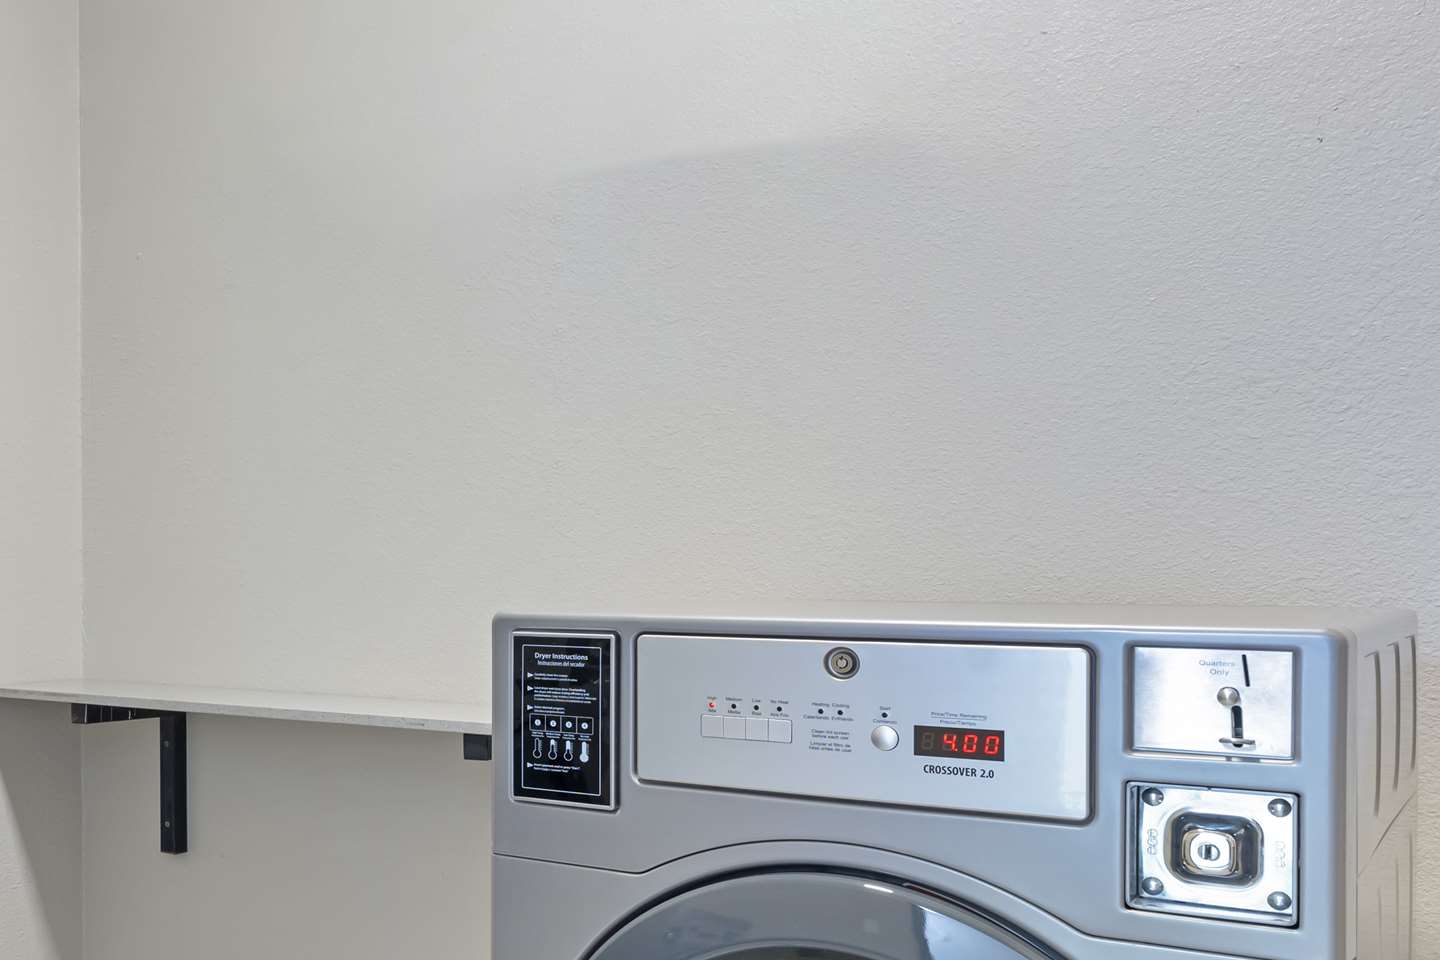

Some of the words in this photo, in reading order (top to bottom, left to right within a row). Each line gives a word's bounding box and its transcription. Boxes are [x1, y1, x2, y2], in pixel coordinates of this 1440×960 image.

[534, 652, 551, 660] Dryer
[1209, 668, 1230, 676] Only
[943, 733, 1000, 755] 4.00
[923, 764, 977, 778] CROSSOVER
[979, 769, 995, 779] 2.0
